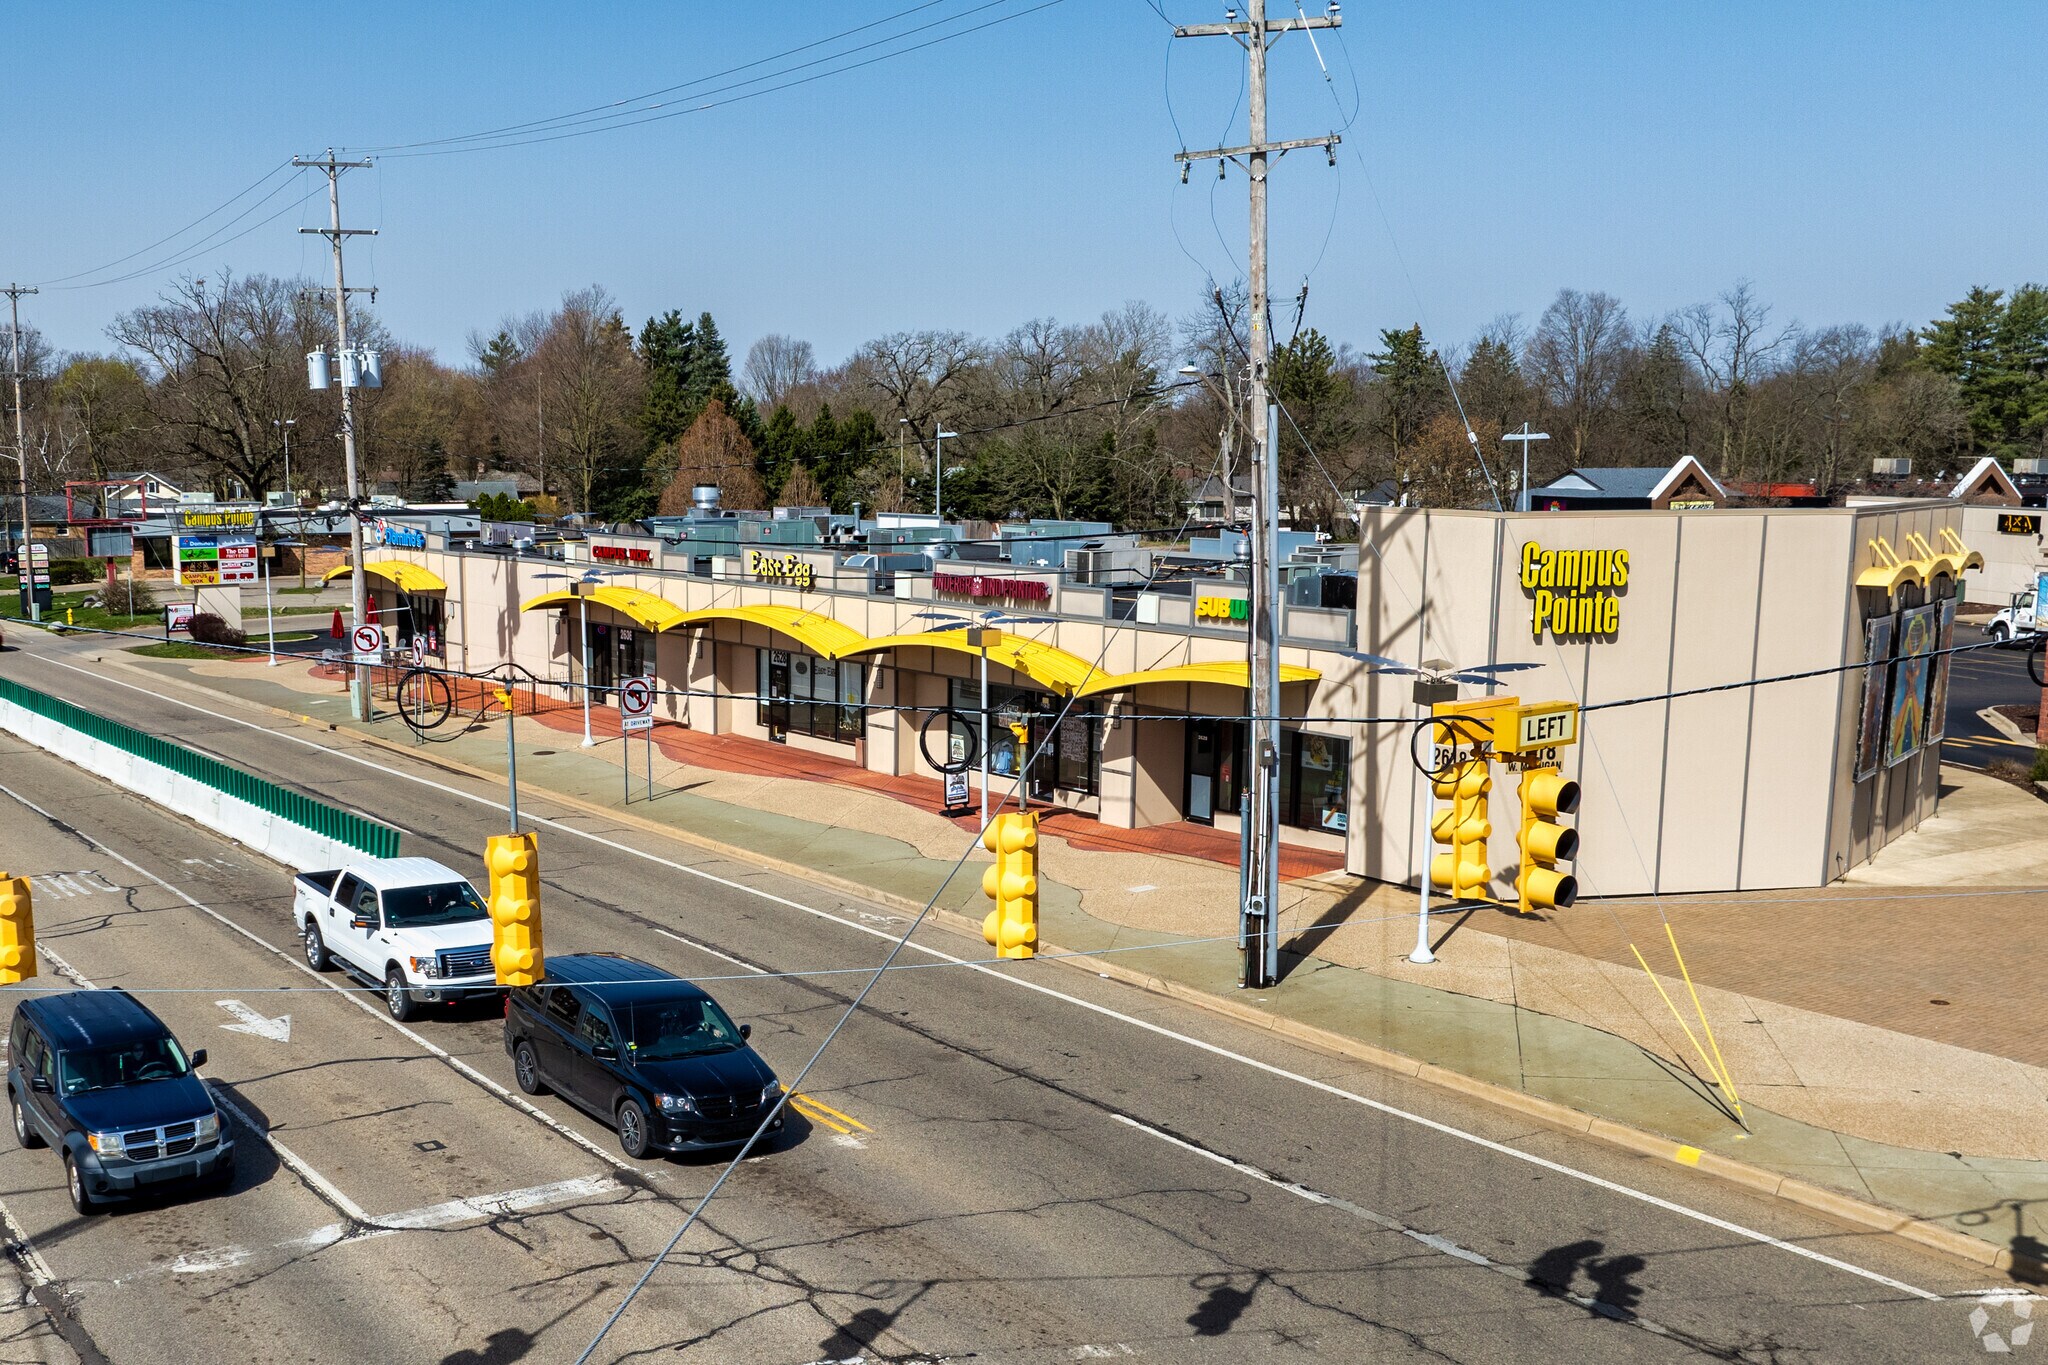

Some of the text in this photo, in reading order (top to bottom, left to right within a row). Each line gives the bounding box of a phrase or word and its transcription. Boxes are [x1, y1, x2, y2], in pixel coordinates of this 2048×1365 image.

[184, 510, 254, 527] Campus Pointe
[385, 527, 426, 548] Domino's
[593, 545, 651, 562] CAMPUS WOK
[750, 551, 811, 587] East Egg
[1522, 541, 1629, 594] Campus
[1003, 579, 1047, 601] PRINTING
[1533, 589, 1620, 634] Pointe
[1527, 715, 1567, 742] LEFT
